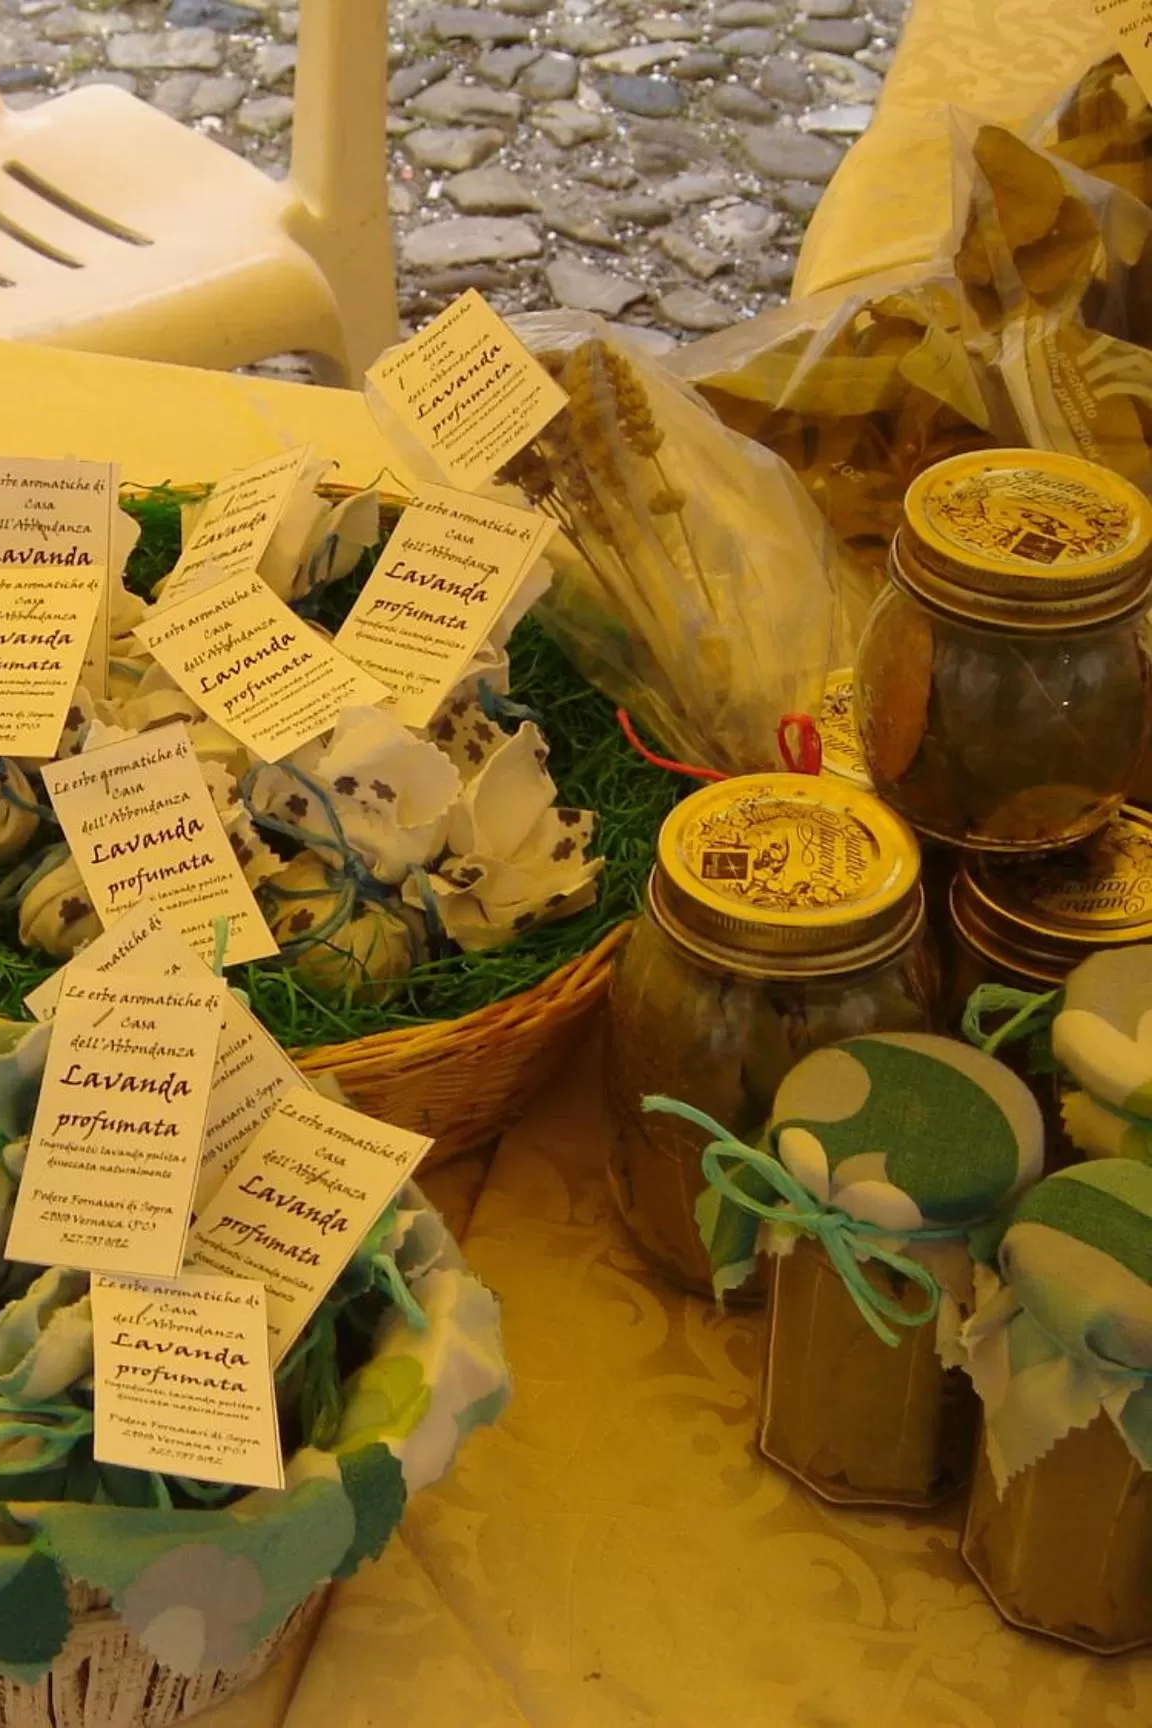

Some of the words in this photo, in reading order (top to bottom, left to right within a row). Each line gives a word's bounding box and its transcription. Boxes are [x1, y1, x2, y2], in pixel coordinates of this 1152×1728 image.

[416, 344, 501, 420] Lavanda
[432, 363, 512, 439] profumata
[20, 478, 90, 491] aromatiche
[93, 479, 104, 493] di
[24, 499, 55, 511] Casa
[445, 529, 474, 545] Casa
[385, 562, 488, 605] Lavanda
[188, 591, 248, 627] aromatiche
[366, 598, 468, 630] profumata
[204, 621, 233, 640] Casa
[200, 631, 296, 694] Lavanda
[223, 652, 313, 716] profumata
[54, 782, 71, 796] Le
[72, 771, 97, 788] erbe
[101, 748, 172, 782] aromatiche
[175, 743, 188, 759] di
[112, 783, 145, 801] Casa
[91, 816, 204, 865] Lavanda
[108, 851, 214, 905] profumata
[149, 916, 163, 932] di
[65, 985, 85, 997] Le
[88, 987, 117, 1002] erbe
[119, 992, 202, 1007] aromatiche
[204, 995, 220, 1012] di
[120, 1016, 157, 1030] Casa
[59, 1064, 192, 1103] Lavanda
[54, 1109, 181, 1142] profumata
[324, 1124, 397, 1160] aromatiche
[314, 1146, 346, 1167] Casa
[239, 1175, 349, 1236] Lavanda
[212, 1213, 321, 1267] profumata
[97, 1277, 116, 1288] Le
[119, 1279, 150, 1293] erbe
[153, 1286, 242, 1304] aromatiche
[245, 1294, 259, 1309] di
[159, 1302, 198, 1317] Casa
[111, 1332, 250, 1369] Lavanda
[115, 1363, 247, 1393] profumata
